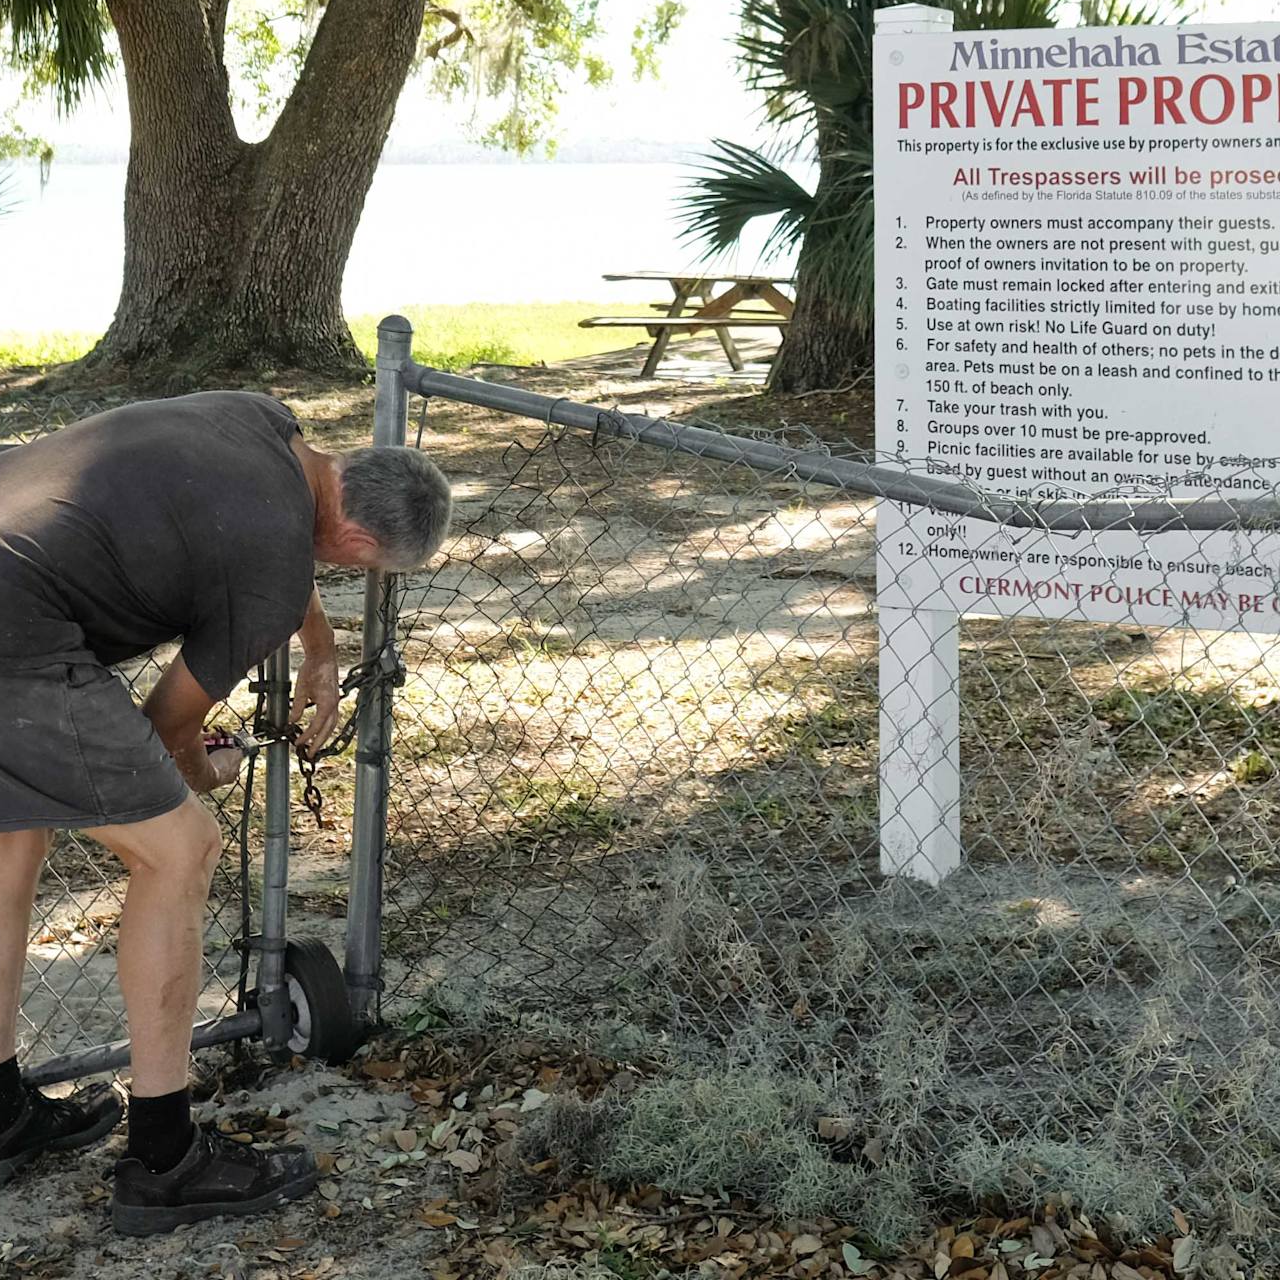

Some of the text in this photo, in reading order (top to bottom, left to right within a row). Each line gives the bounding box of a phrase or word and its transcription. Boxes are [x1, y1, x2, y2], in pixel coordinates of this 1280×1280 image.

[949, 34, 1162, 71] Minnehaha
[899, 78, 1099, 129] PRIVATE
[897, 139, 922, 152] This
[925, 138, 980, 155] property
[983, 138, 994, 151] is
[995, 137, 1014, 151] for
[1016, 137, 1038, 152] the
[1041, 136, 1100, 150] exclusive
[1103, 139, 1126, 150] use
[1128, 136, 1145, 153] by
[1148, 137, 1209, 153] property
[1211, 137, 1262, 149] owners
[953, 168, 980, 186] All
[987, 168, 1121, 192] Trespassers
[1129, 166, 1166, 185] will
[1175, 166, 1201, 185] be
[896, 216, 1275, 233] 1. Property owners must accompany their guests.
[895, 236, 907, 249] 2.
[925, 236, 965, 250] When
[969, 236, 994, 252] the
[994, 239, 1048, 252] owners
[1053, 240, 1076, 251] are
[1081, 237, 1105, 252] not
[1109, 238, 1167, 254] present
[1170, 237, 1202, 251] with
[1207, 238, 1255, 255] guest,
[925, 256, 1248, 276] proof of owners invitation to be on property.
[896, 277, 907, 290] 3.
[926, 276, 959, 290] Gate
[963, 278, 998, 291] must
[1002, 278, 1052, 292] remain
[1057, 278, 1105, 295] locked
[1109, 278, 1144, 293] after
[1148, 280, 1211, 297] entering
[1216, 280, 1245, 295] and
[896, 297, 907, 310] 4.
[926, 296, 981, 315] Boating
[984, 298, 1046, 312] facilities
[1050, 299, 1100, 317] strictly
[1105, 300, 1155, 314] limited
[1160, 301, 1182, 315] for
[1187, 304, 1214, 315] use
[1219, 302, 1237, 319] by
[896, 317, 1215, 340] 5. Use at own risk! No Life Guard on duty!
[896, 338, 908, 351] 6.
[927, 338, 953, 352] For
[954, 339, 997, 357] safety
[1001, 340, 1028, 354] and
[1033, 340, 1080, 355] health
[1080, 342, 1097, 357] of
[1100, 342, 1154, 360] others;
[1159, 345, 1178, 361] no
[1183, 344, 1216, 362] pets
[1221, 344, 1235, 359] in
[1240, 345, 1264, 360] the
[925, 361, 960, 374] area.
[962, 360, 994, 374] Pets
[997, 362, 1035, 376] must
[1039, 361, 1057, 376] be
[1061, 364, 1082, 377] on
[1084, 366, 1093, 376] a
[1096, 363, 1138, 380] leash
[1142, 364, 1171, 379] and
[1174, 365, 1243, 381] confined
[1248, 368, 1264, 381] to
[896, 399, 1108, 422] 7. Take your trash with you.
[896, 419, 1211, 446] 8. Groups over 10 must be pre-approved.
[960, 576, 1082, 601] CLERMONT
[1091, 585, 1173, 607] POLICE
[1182, 590, 1230, 613] MAY
[1239, 594, 1266, 613] BE
